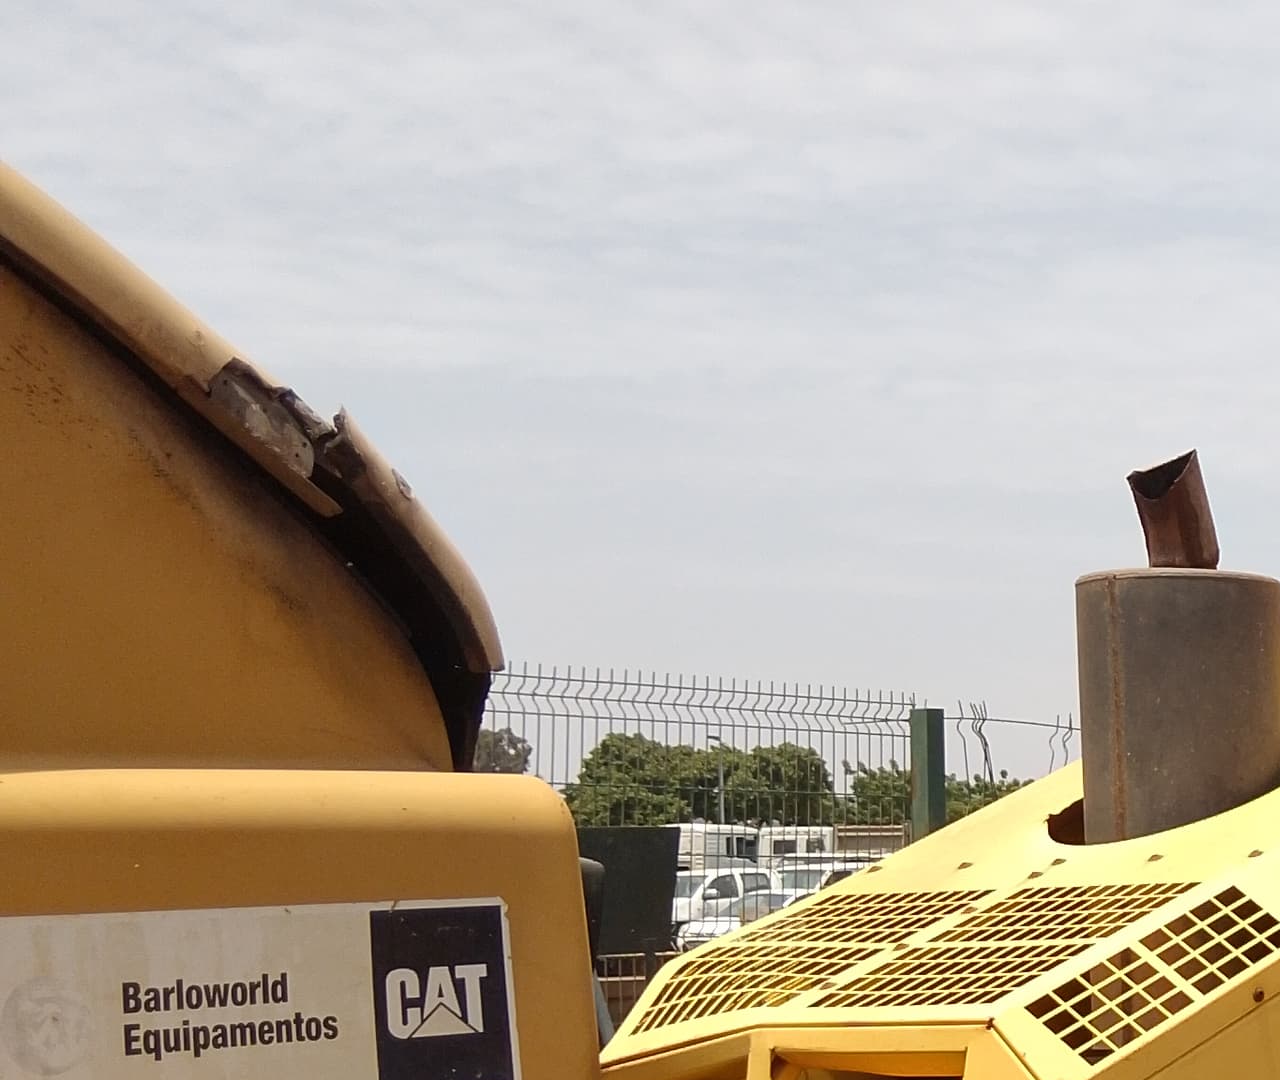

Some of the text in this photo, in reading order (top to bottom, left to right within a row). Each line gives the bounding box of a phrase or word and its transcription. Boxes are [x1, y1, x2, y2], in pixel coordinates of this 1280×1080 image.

[122, 972, 289, 1015] Barloworld
[385, 963, 489, 1040] CAT
[123, 1012, 340, 1061] Equipamentos
